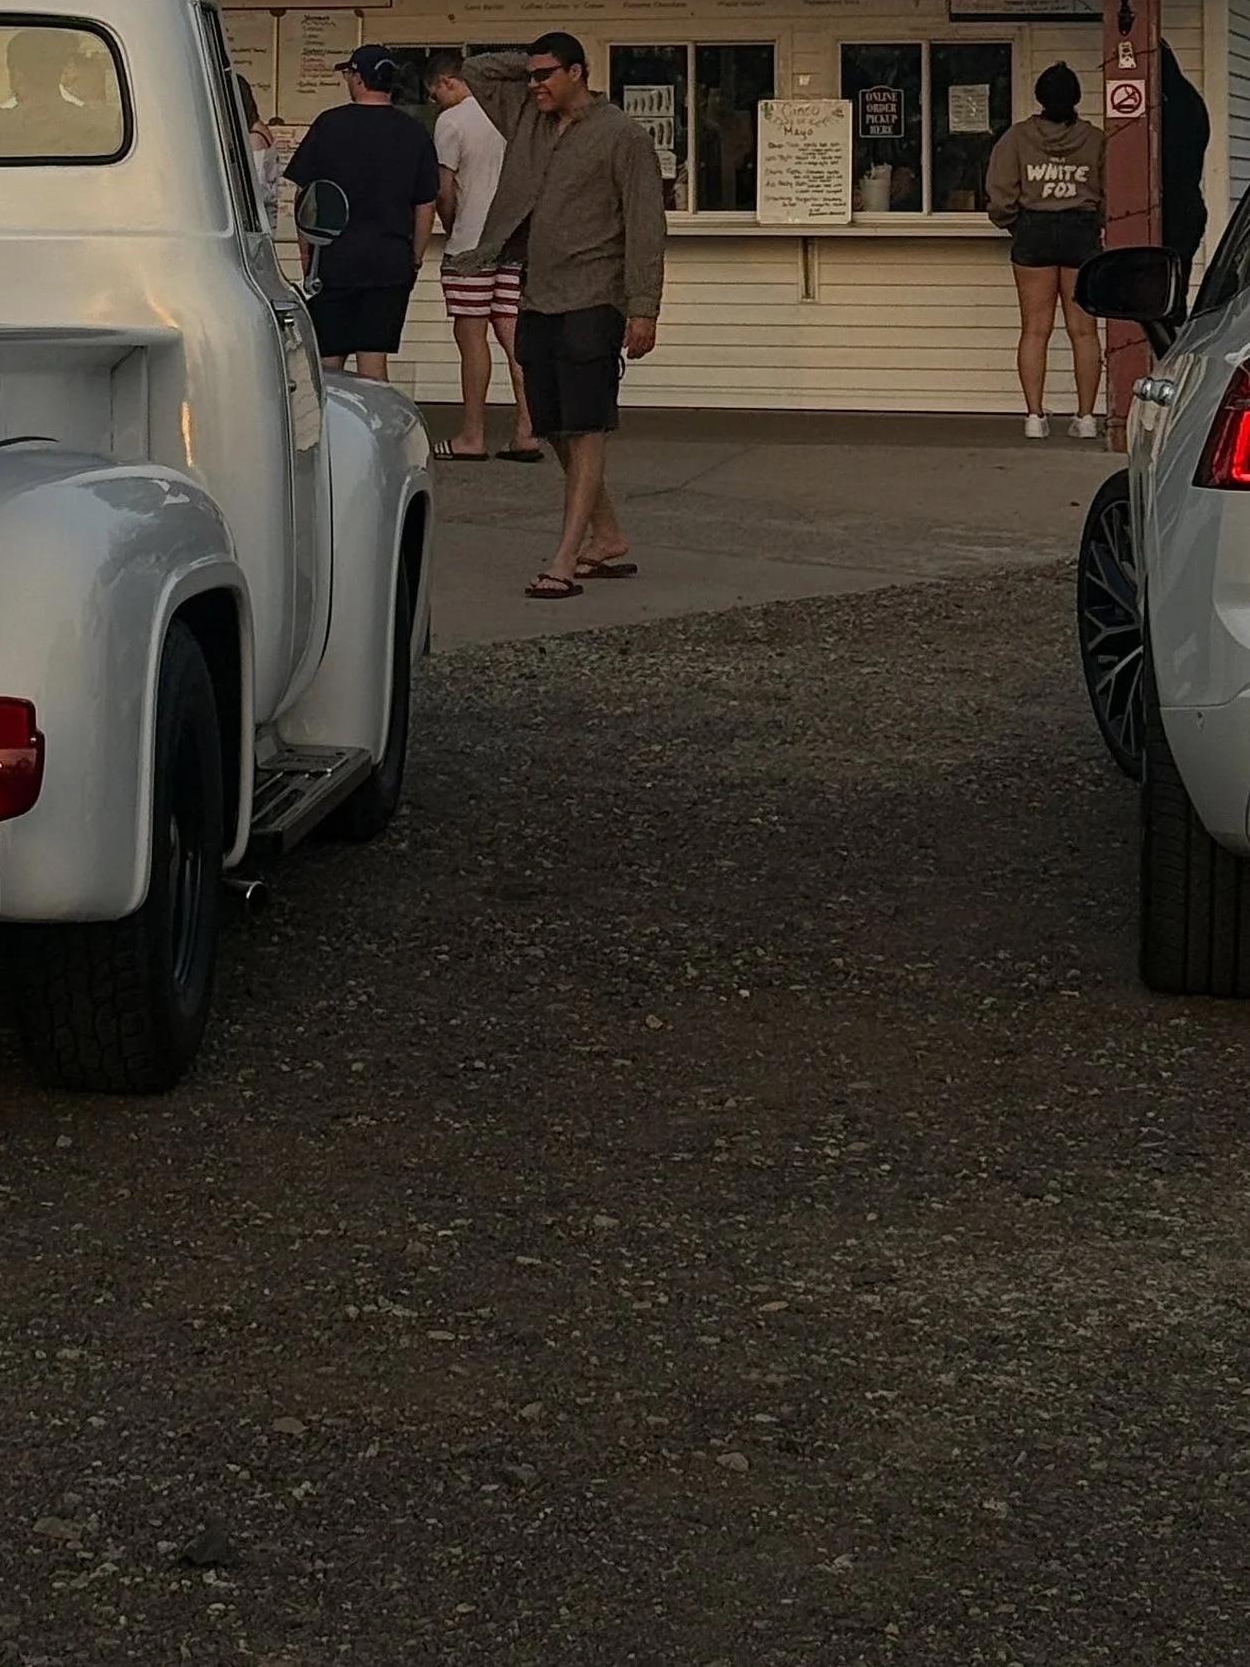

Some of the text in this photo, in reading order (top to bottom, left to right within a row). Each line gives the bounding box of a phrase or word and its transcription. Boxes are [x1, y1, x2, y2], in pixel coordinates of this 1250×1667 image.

[865, 91, 898, 102] ONLINE
[865, 103, 897, 113] ORDER
[865, 114, 898, 124] PICKUP
[783, 125, 813, 140] Mayo
[869, 125, 894, 135] HERE
[1026, 162, 1090, 182] WHITE
[1041, 182, 1077, 198] FOX
